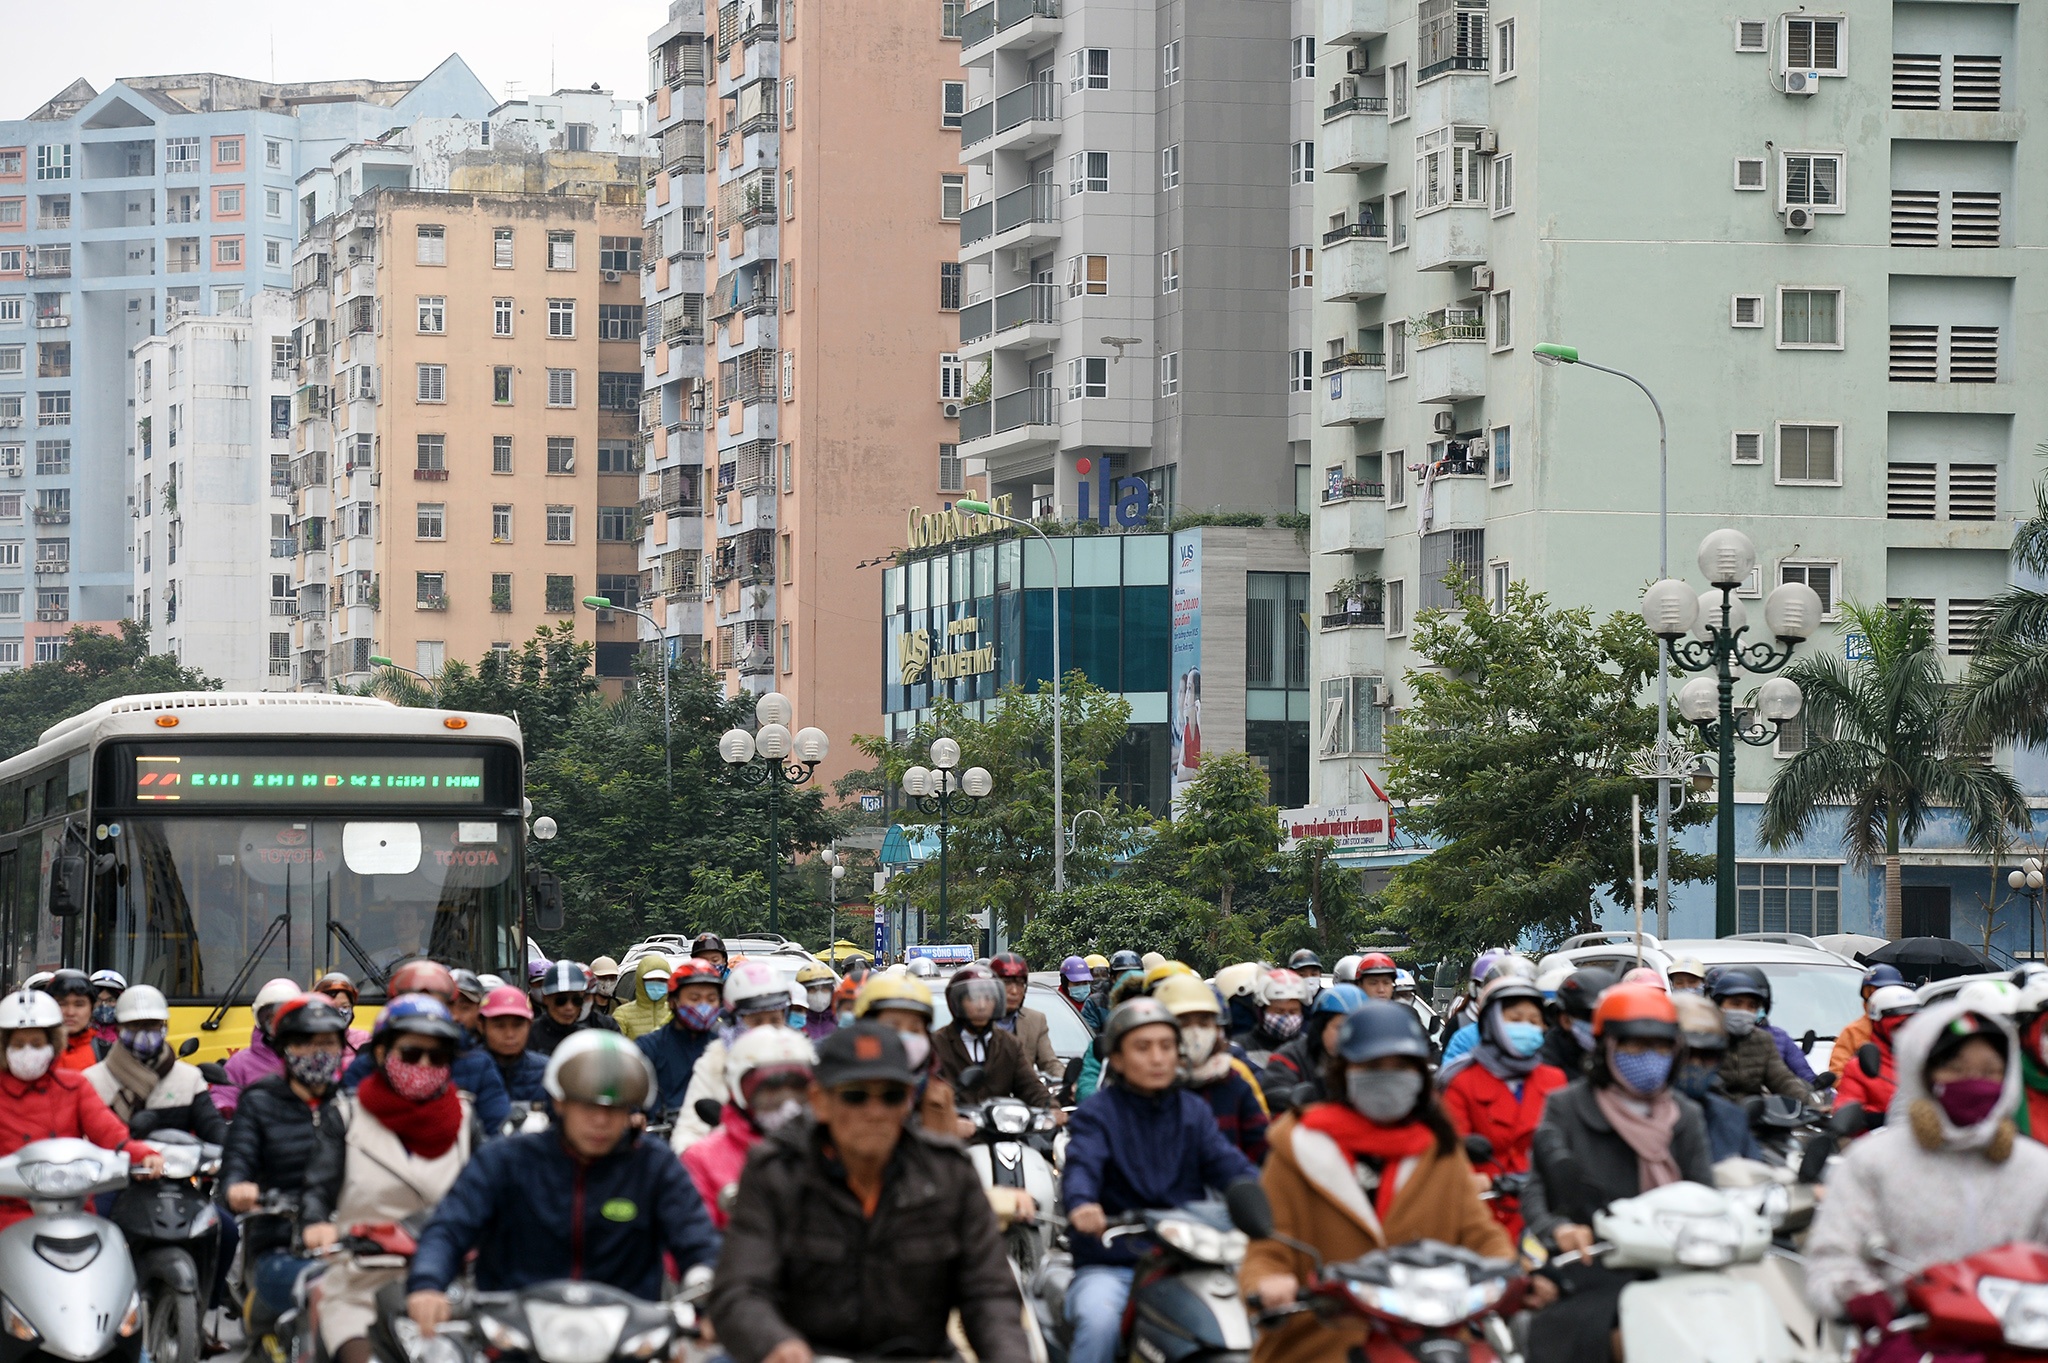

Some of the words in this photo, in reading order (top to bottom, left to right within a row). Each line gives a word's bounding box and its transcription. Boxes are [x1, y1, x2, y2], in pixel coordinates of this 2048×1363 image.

[1076, 457, 1150, 528] ila
[862, 797, 880, 812] N3B
[258, 848, 326, 863] TOYOTA
[434, 850, 498, 866] TOYOTA
